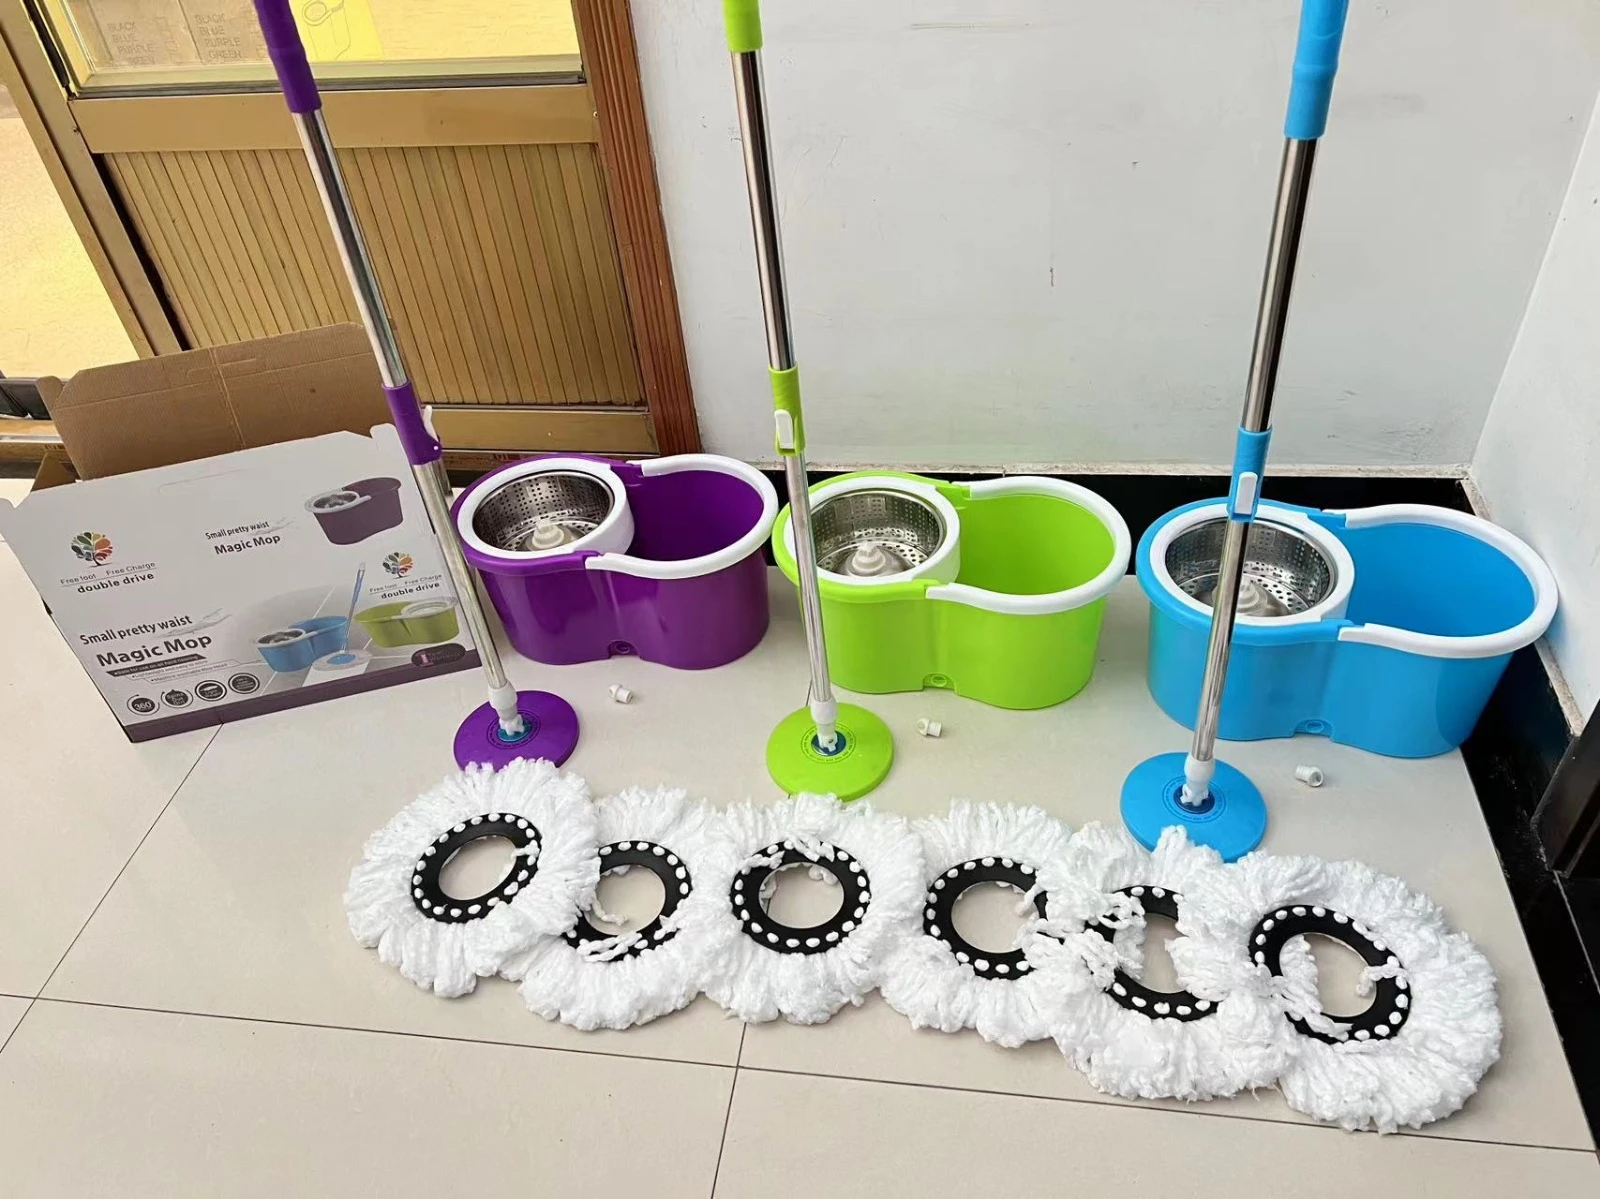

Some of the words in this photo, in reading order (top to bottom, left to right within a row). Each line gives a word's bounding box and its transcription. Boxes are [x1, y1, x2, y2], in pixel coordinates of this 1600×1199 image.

[112, 33, 136, 43] BLUE
[200, 25, 225, 35] BLUE
[208, 49, 242, 59] GREEN
[205, 529, 227, 540] Small
[227, 525, 249, 536] pretty
[249, 521, 270, 531] waist
[214, 540, 253, 555] Magic
[252, 535, 281, 547] Mop
[60, 577, 79, 585] Free
[105, 568, 125, 576] Free
[126, 562, 156, 572] Charge
[77, 580, 120, 593] double
[122, 573, 155, 585] drive
[381, 588, 414, 599] double
[415, 582, 440, 592] drive
[80, 629, 117, 645] Small
[117, 623, 157, 640] pretty
[157, 614, 193, 631] waist
[96, 645, 163, 667] Magic
[163, 635, 212, 654] Mop
[134, 701, 152, 711] 360
